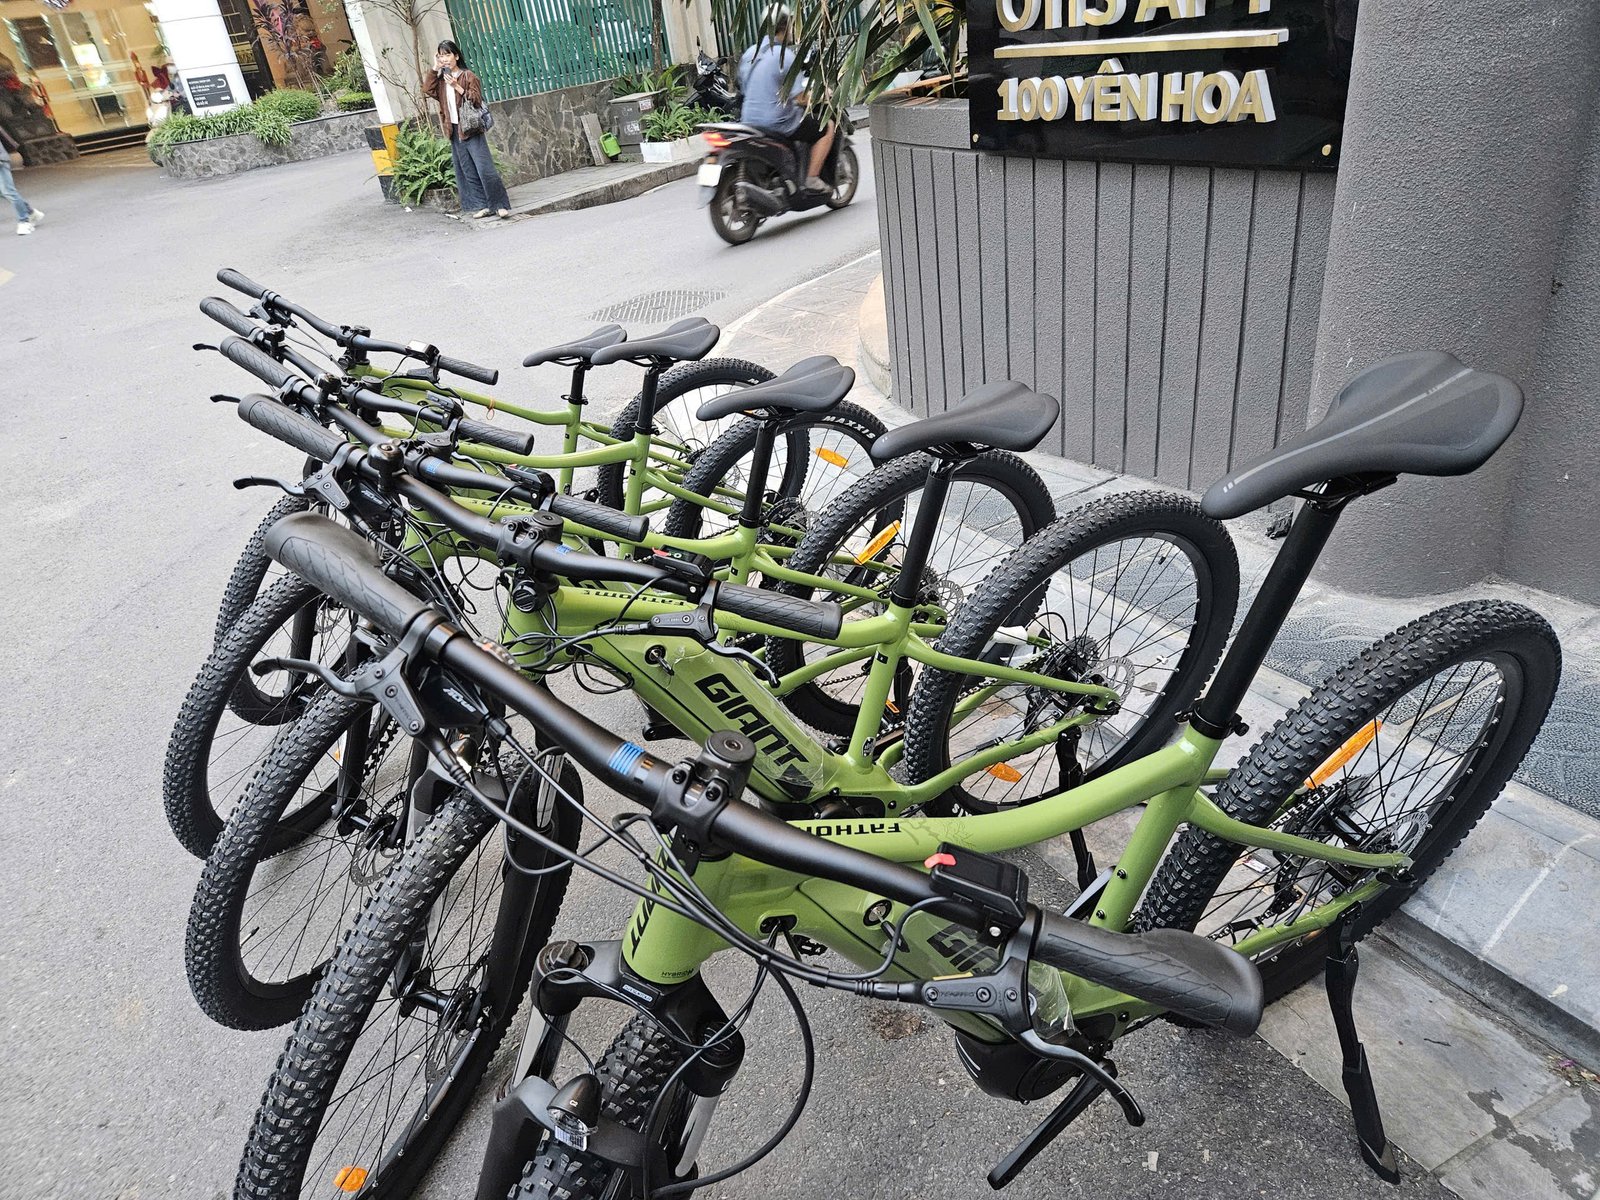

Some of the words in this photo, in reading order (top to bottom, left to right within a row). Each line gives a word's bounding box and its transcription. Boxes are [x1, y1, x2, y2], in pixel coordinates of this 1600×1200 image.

[997, 75, 1068, 122] 100
[1066, 58, 1158, 122] YÊN
[1161, 70, 1277, 125] HOA
[822, 415, 876, 439] MAXXIS
[694, 673, 809, 767] GIANT
[806, 822, 902, 837] FATHO
